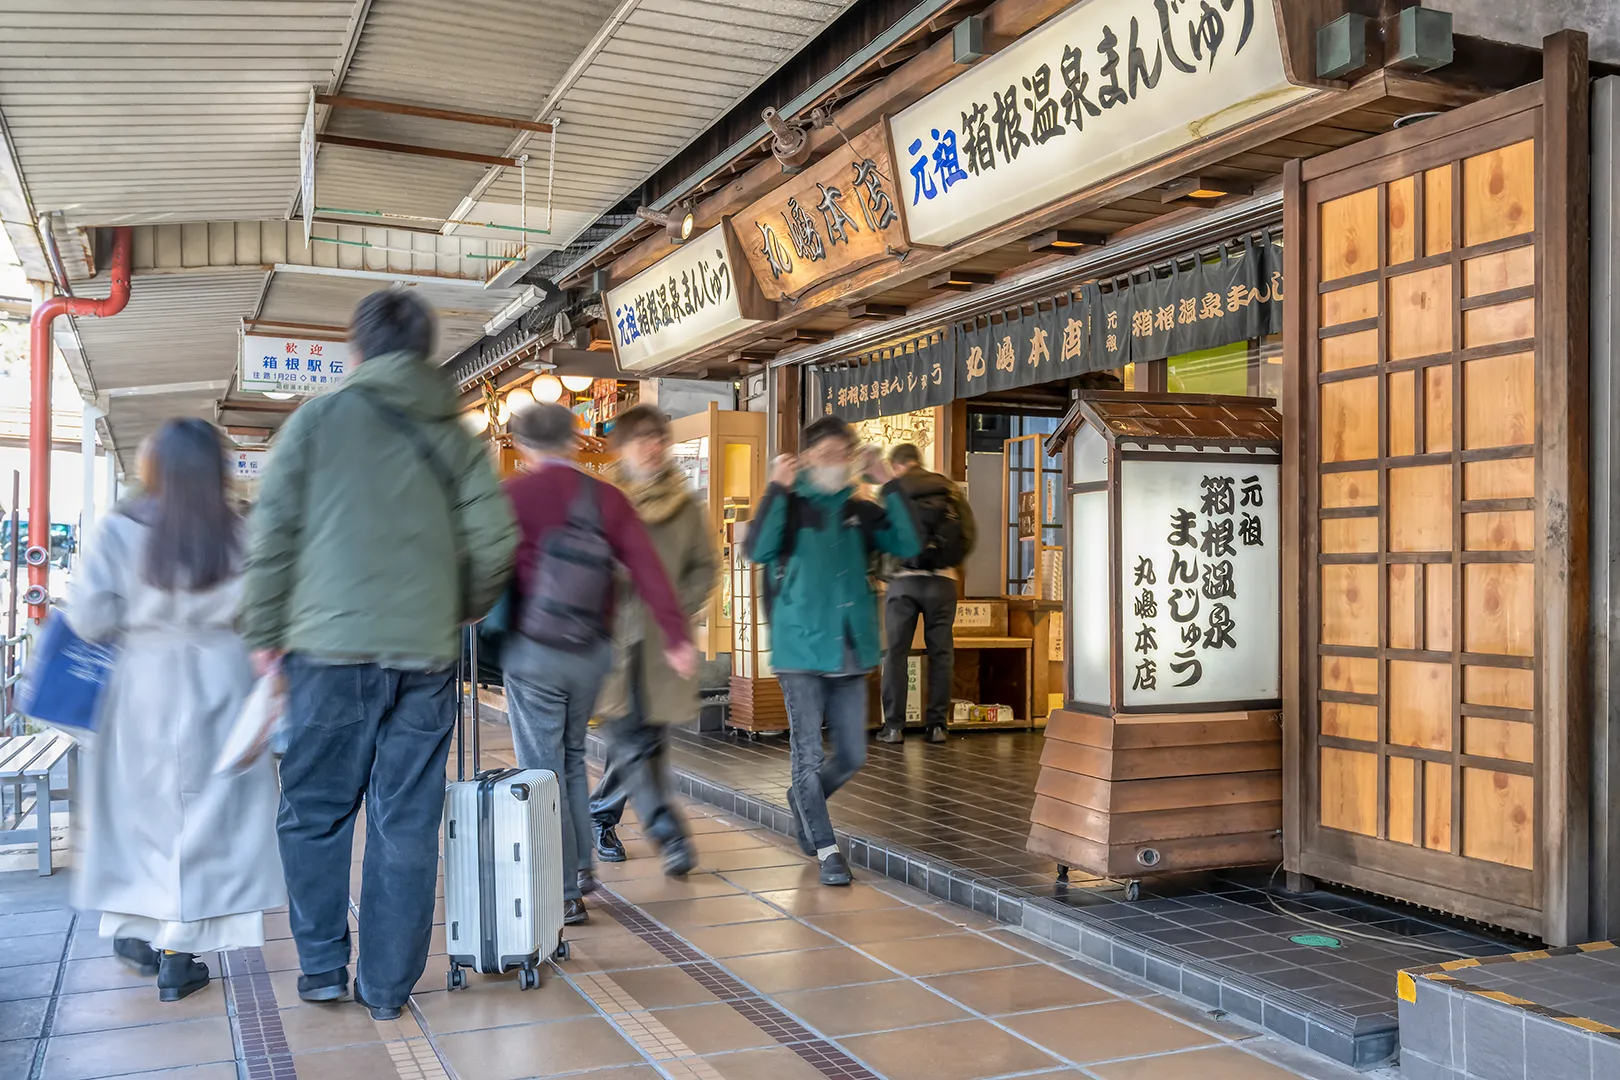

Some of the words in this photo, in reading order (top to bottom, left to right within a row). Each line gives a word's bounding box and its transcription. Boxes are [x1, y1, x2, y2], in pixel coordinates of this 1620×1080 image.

[285, 342, 323, 356] 歓迎
[965, 317, 1083, 382] 丸嶋本店
[1106, 310, 1118, 353] 元祖
[263, 356, 344, 374] 箱根駅伝
[237, 461, 258, 469] 駅伝
[1238, 475, 1264, 546] 元祖
[1200, 474, 1236, 649] 箱根温泉
[1132, 555, 1158, 691] 丸嶋本店
[1166, 507, 1203, 688] まんじゅう
